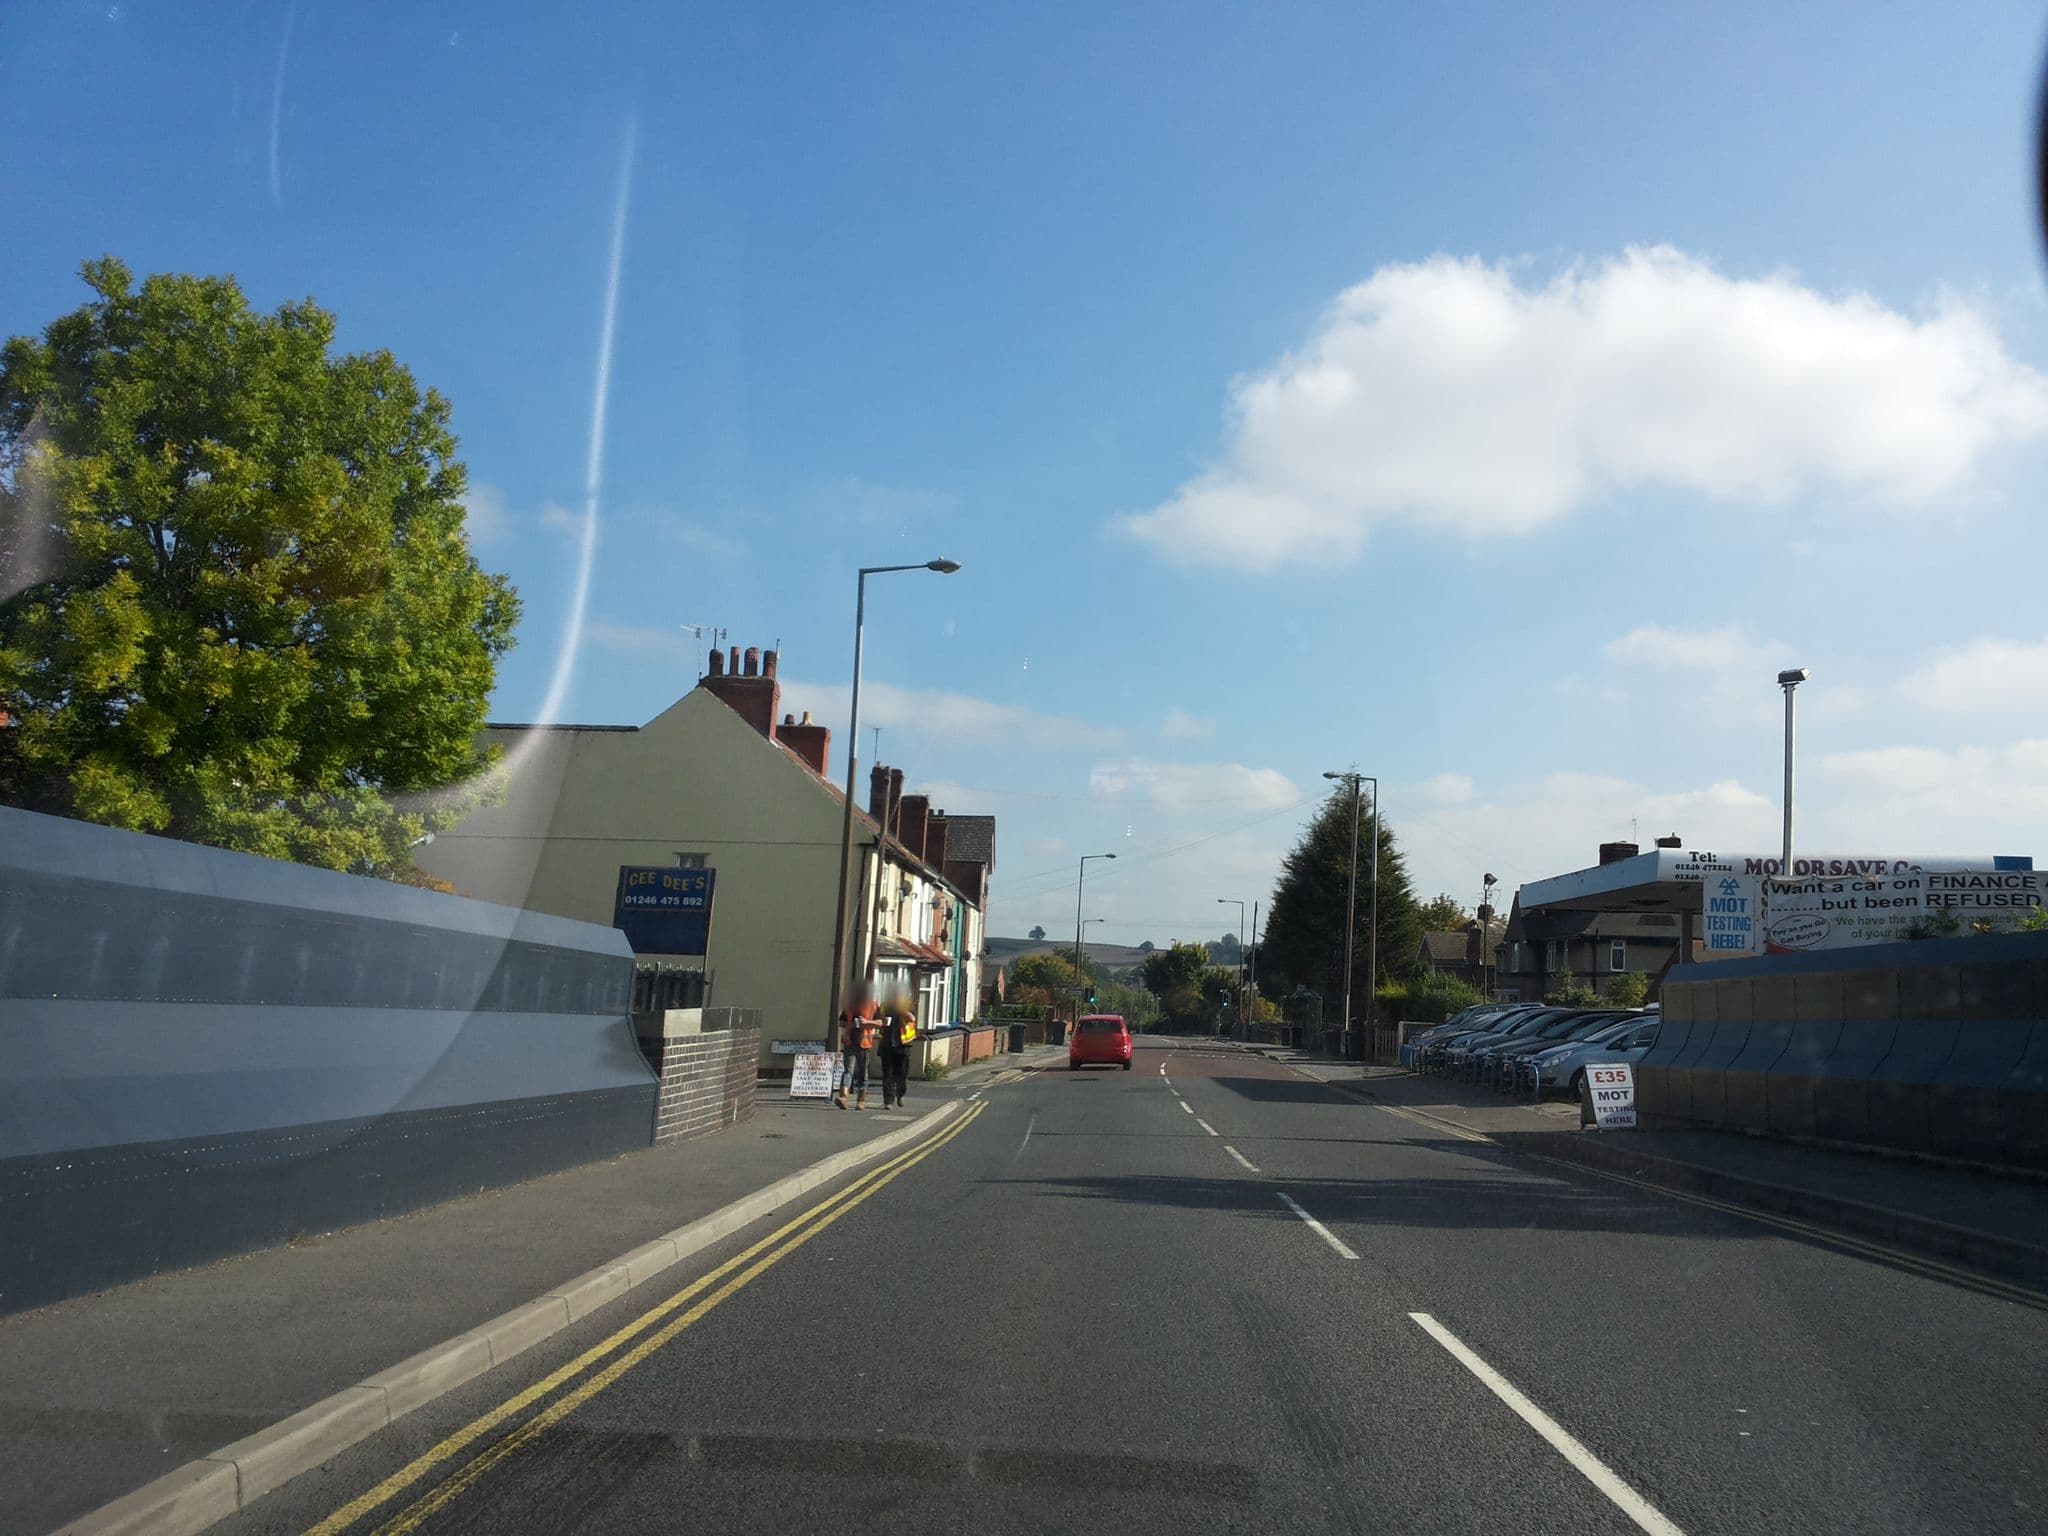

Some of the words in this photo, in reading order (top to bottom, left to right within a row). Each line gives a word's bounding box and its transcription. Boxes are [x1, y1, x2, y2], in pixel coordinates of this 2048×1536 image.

[1689, 851, 1717, 863] Tel:
[1675, 863, 1700, 871] 01246
[1829, 860, 1888, 876] SAVE
[1770, 881, 1825, 895] Want
[1832, 883, 1844, 893] a
[1851, 880, 1886, 892] car
[1893, 878, 1920, 890] on
[1928, 875, 2038, 889] FINANCE
[625, 895, 657, 905] 01246
[660, 896, 680, 905] 475
[1710, 897, 1748, 913] MOT
[1865, 896, 1918, 909] been
[1926, 893, 2042, 907] REFUSED
[1706, 916, 1751, 932] TESTING
[1858, 915, 1885, 925] have
[1889, 915, 1906, 925] the
[1852, 927, 1863, 938] of
[1866, 929, 1893, 940] your
[1711, 933, 1746, 950] HERE!
[1595, 1071, 1627, 1083] £35
[1597, 1090, 1629, 1101] MOT
[1597, 1104, 1636, 1113] TESTING
[1605, 1116, 1633, 1124] HERE
